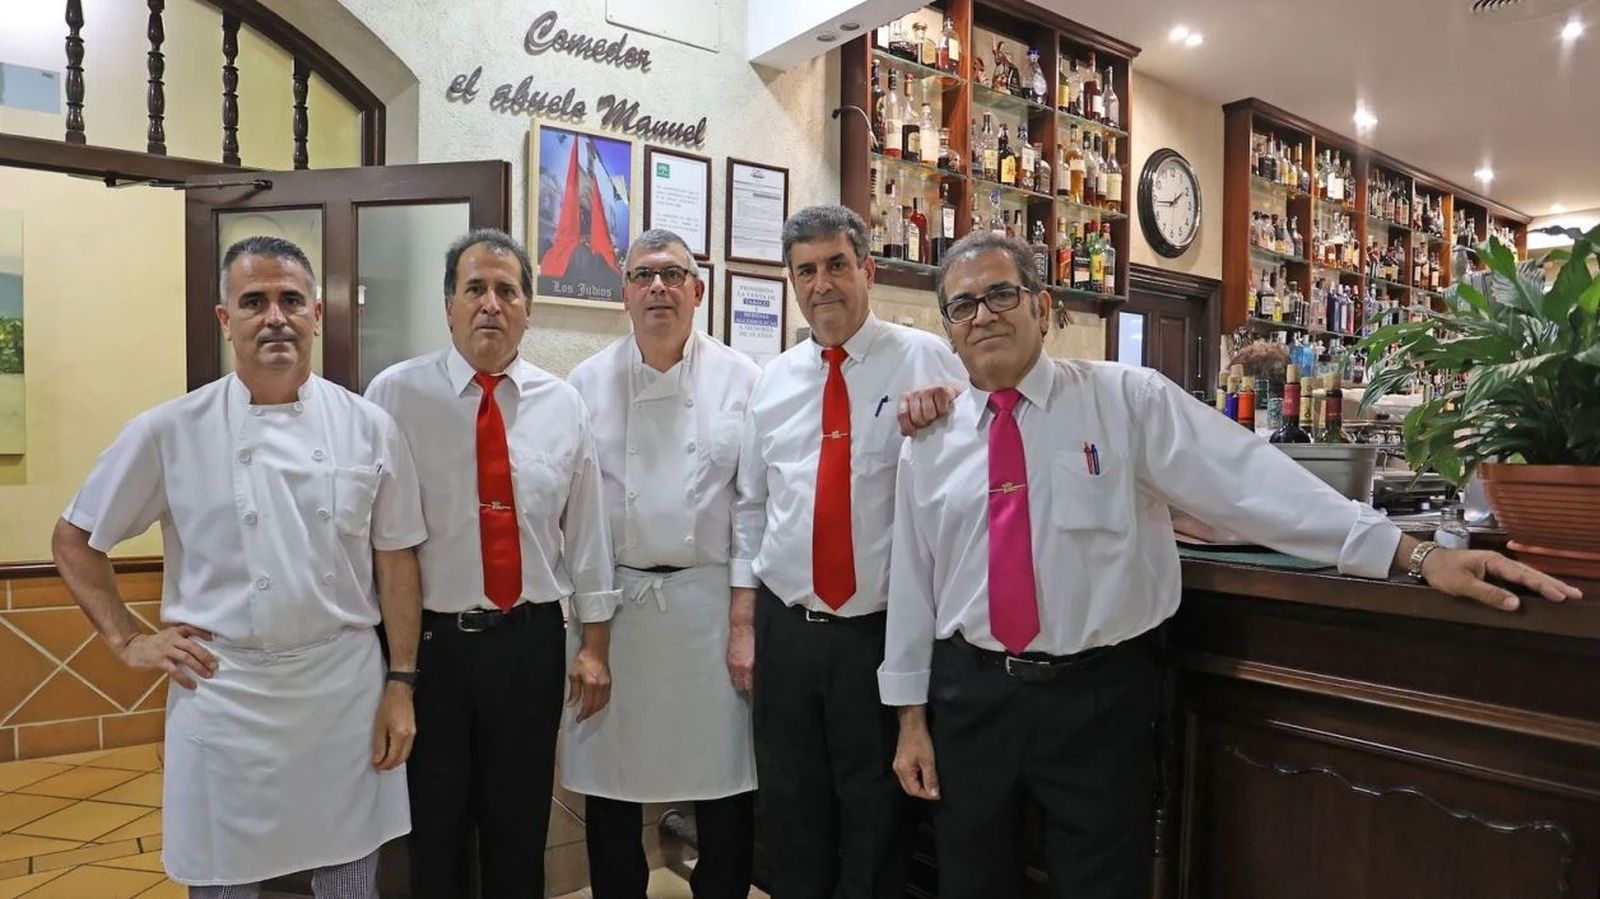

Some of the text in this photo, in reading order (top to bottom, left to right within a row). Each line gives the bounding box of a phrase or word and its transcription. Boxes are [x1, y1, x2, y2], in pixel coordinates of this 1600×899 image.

[524, 10, 652, 71] Comedor
[446, 66, 707, 144] el abuelo Manuel
[552, 280, 574, 294] Los
